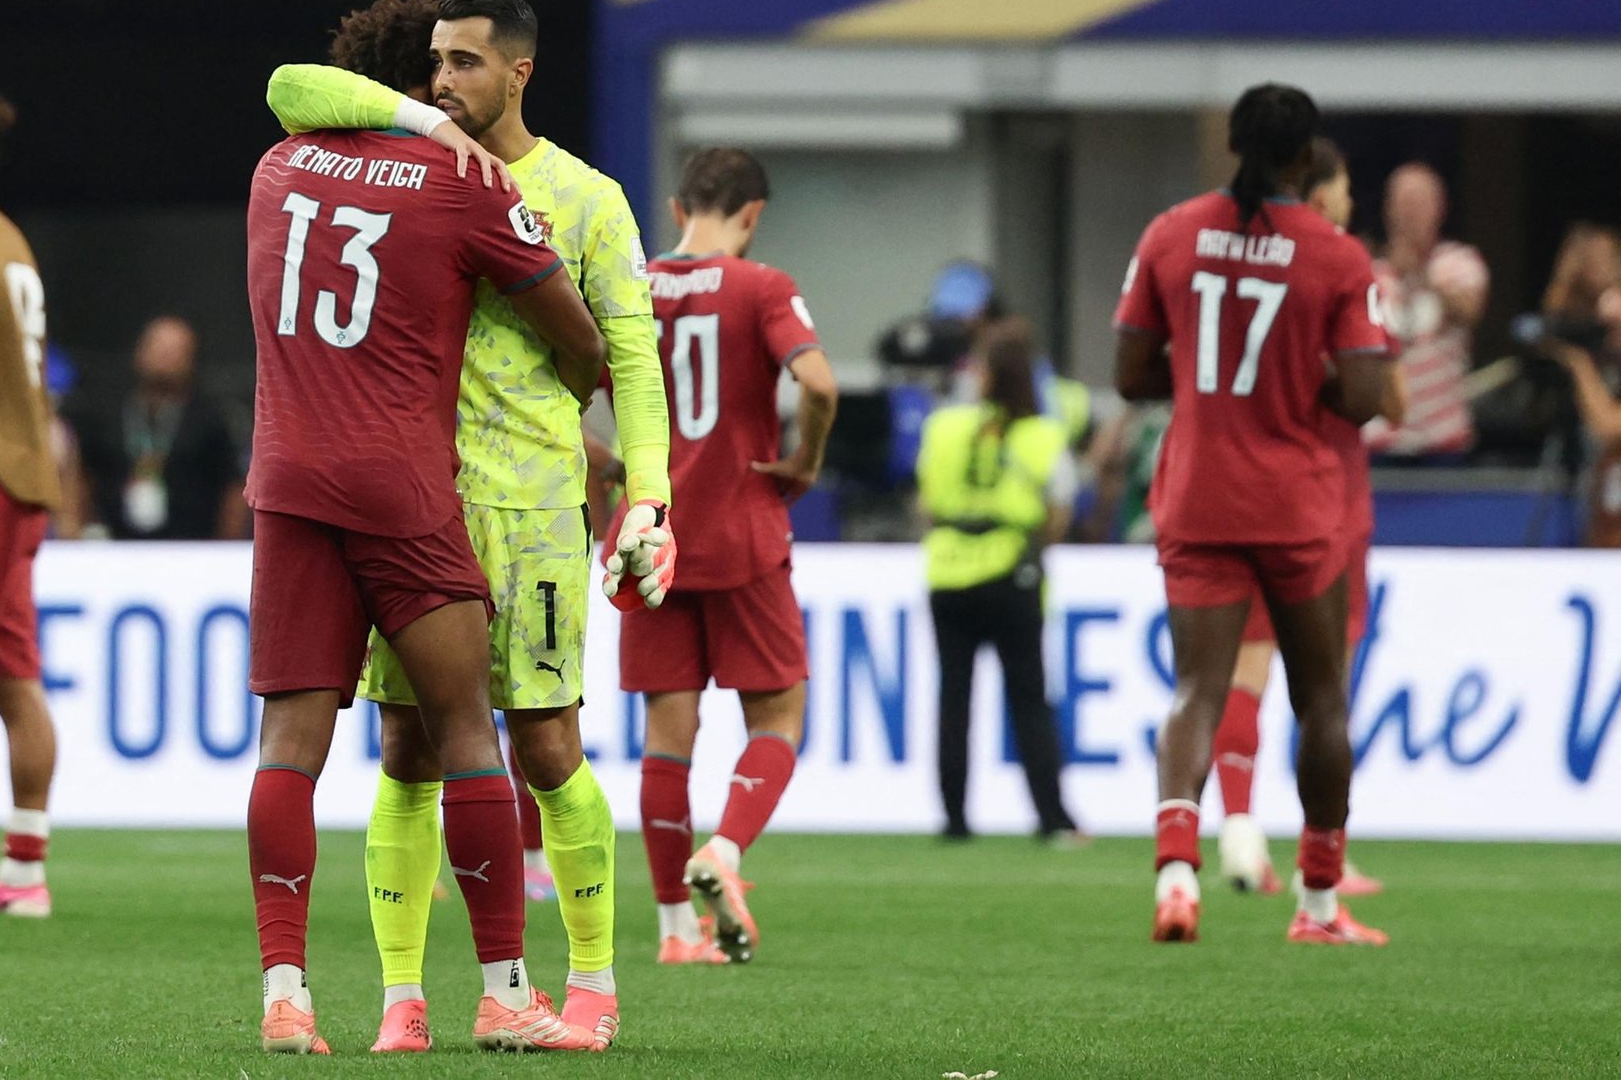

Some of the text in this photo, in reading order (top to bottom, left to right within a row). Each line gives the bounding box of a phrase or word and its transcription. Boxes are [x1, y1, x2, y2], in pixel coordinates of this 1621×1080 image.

[287, 144, 428, 190] RENATO VEIGA
[277, 191, 394, 348] 13
[1191, 271, 1288, 397] 17
[536, 580, 557, 650] 1
